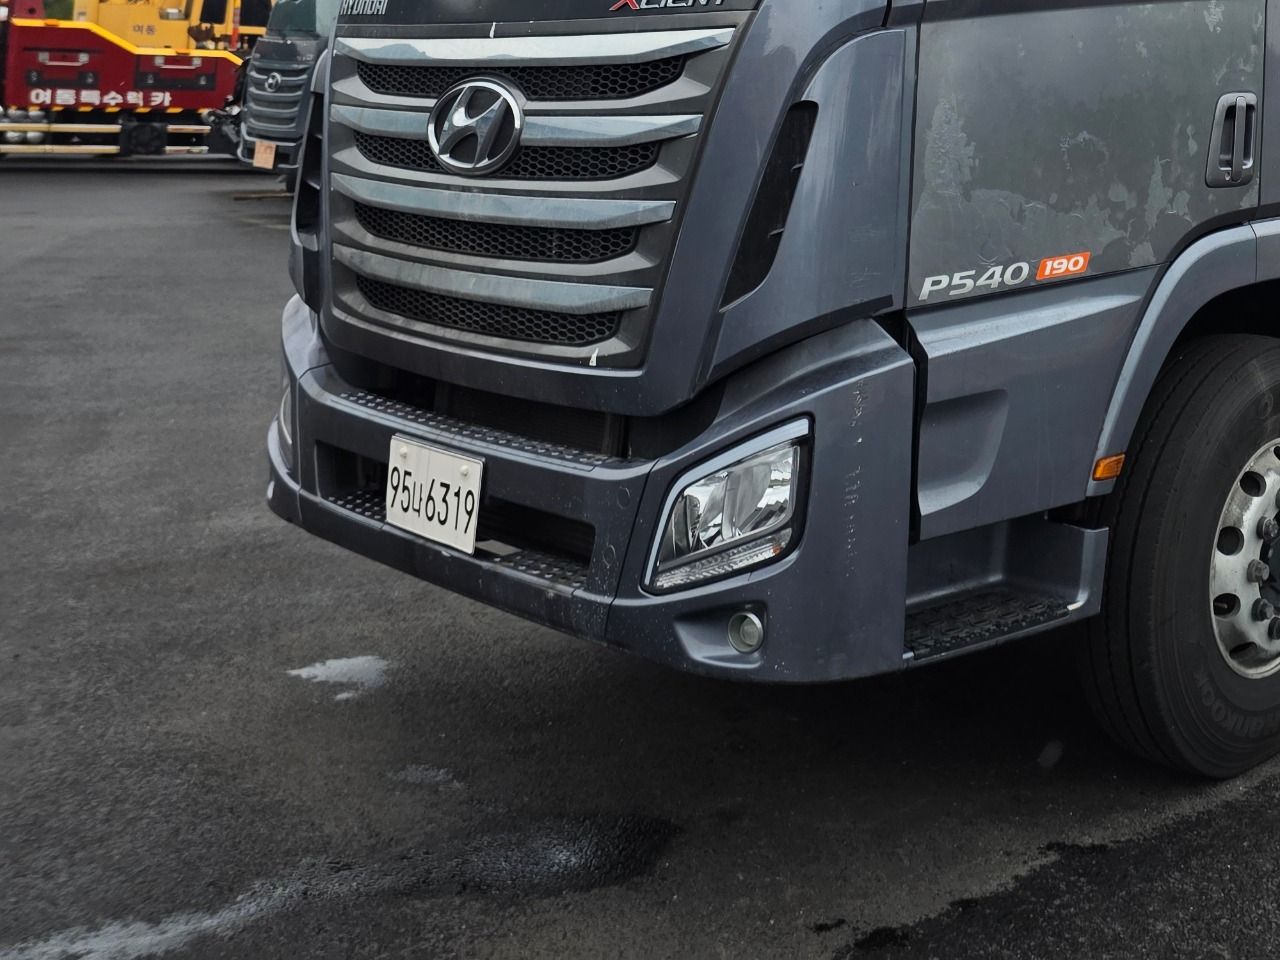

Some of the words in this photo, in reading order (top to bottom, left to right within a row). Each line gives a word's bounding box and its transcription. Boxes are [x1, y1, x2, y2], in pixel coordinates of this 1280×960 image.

[918, 261, 1030, 301] P540
[1044, 256, 1085, 276] 190
[390, 466, 475, 534] 95나6319
